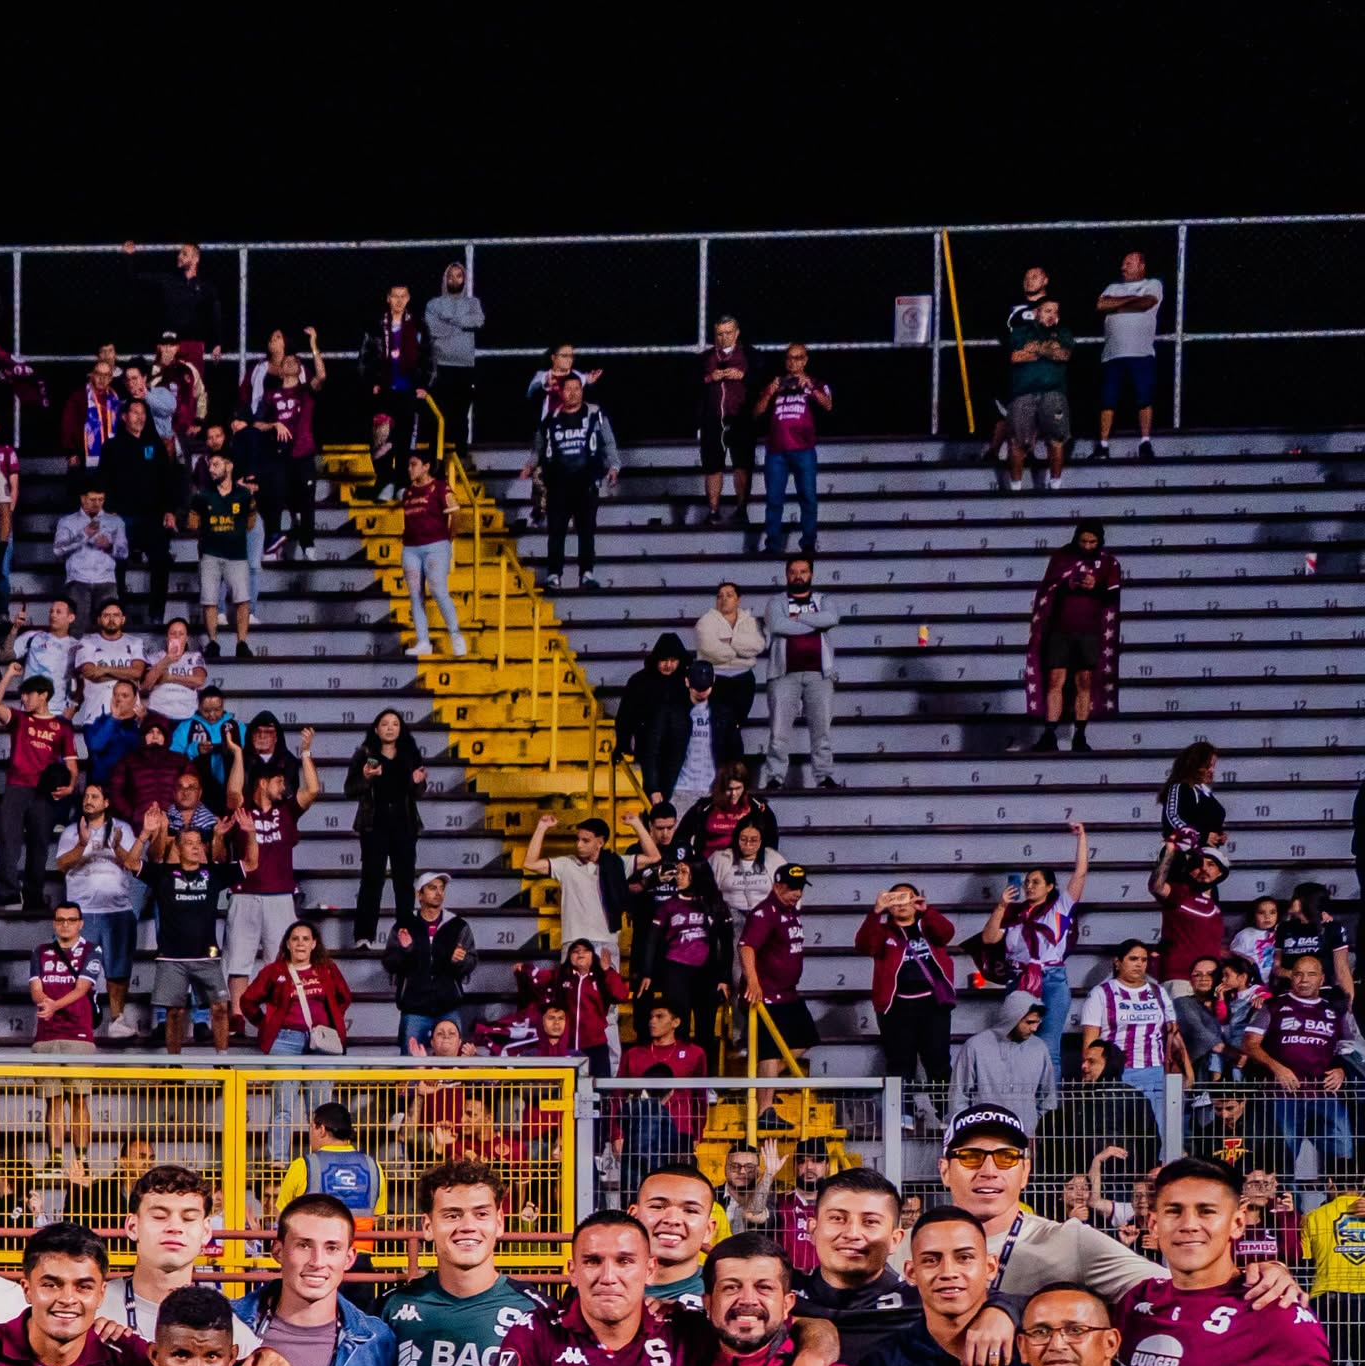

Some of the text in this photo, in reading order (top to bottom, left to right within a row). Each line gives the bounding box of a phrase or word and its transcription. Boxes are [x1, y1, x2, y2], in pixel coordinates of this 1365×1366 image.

[382, 677, 398, 688] 20
[446, 816, 462, 826] 20
[463, 853, 479, 864] 20
[480, 892, 497, 903] 20
[497, 932, 514, 943] 20
[837, 974, 845, 986] 2
[1304, 1020, 1334, 1032] BAC
[1281, 1035, 1328, 1046] LIBERTY
[1171, 1307, 1181, 1321] 6
[1202, 1306, 1238, 1334] S
